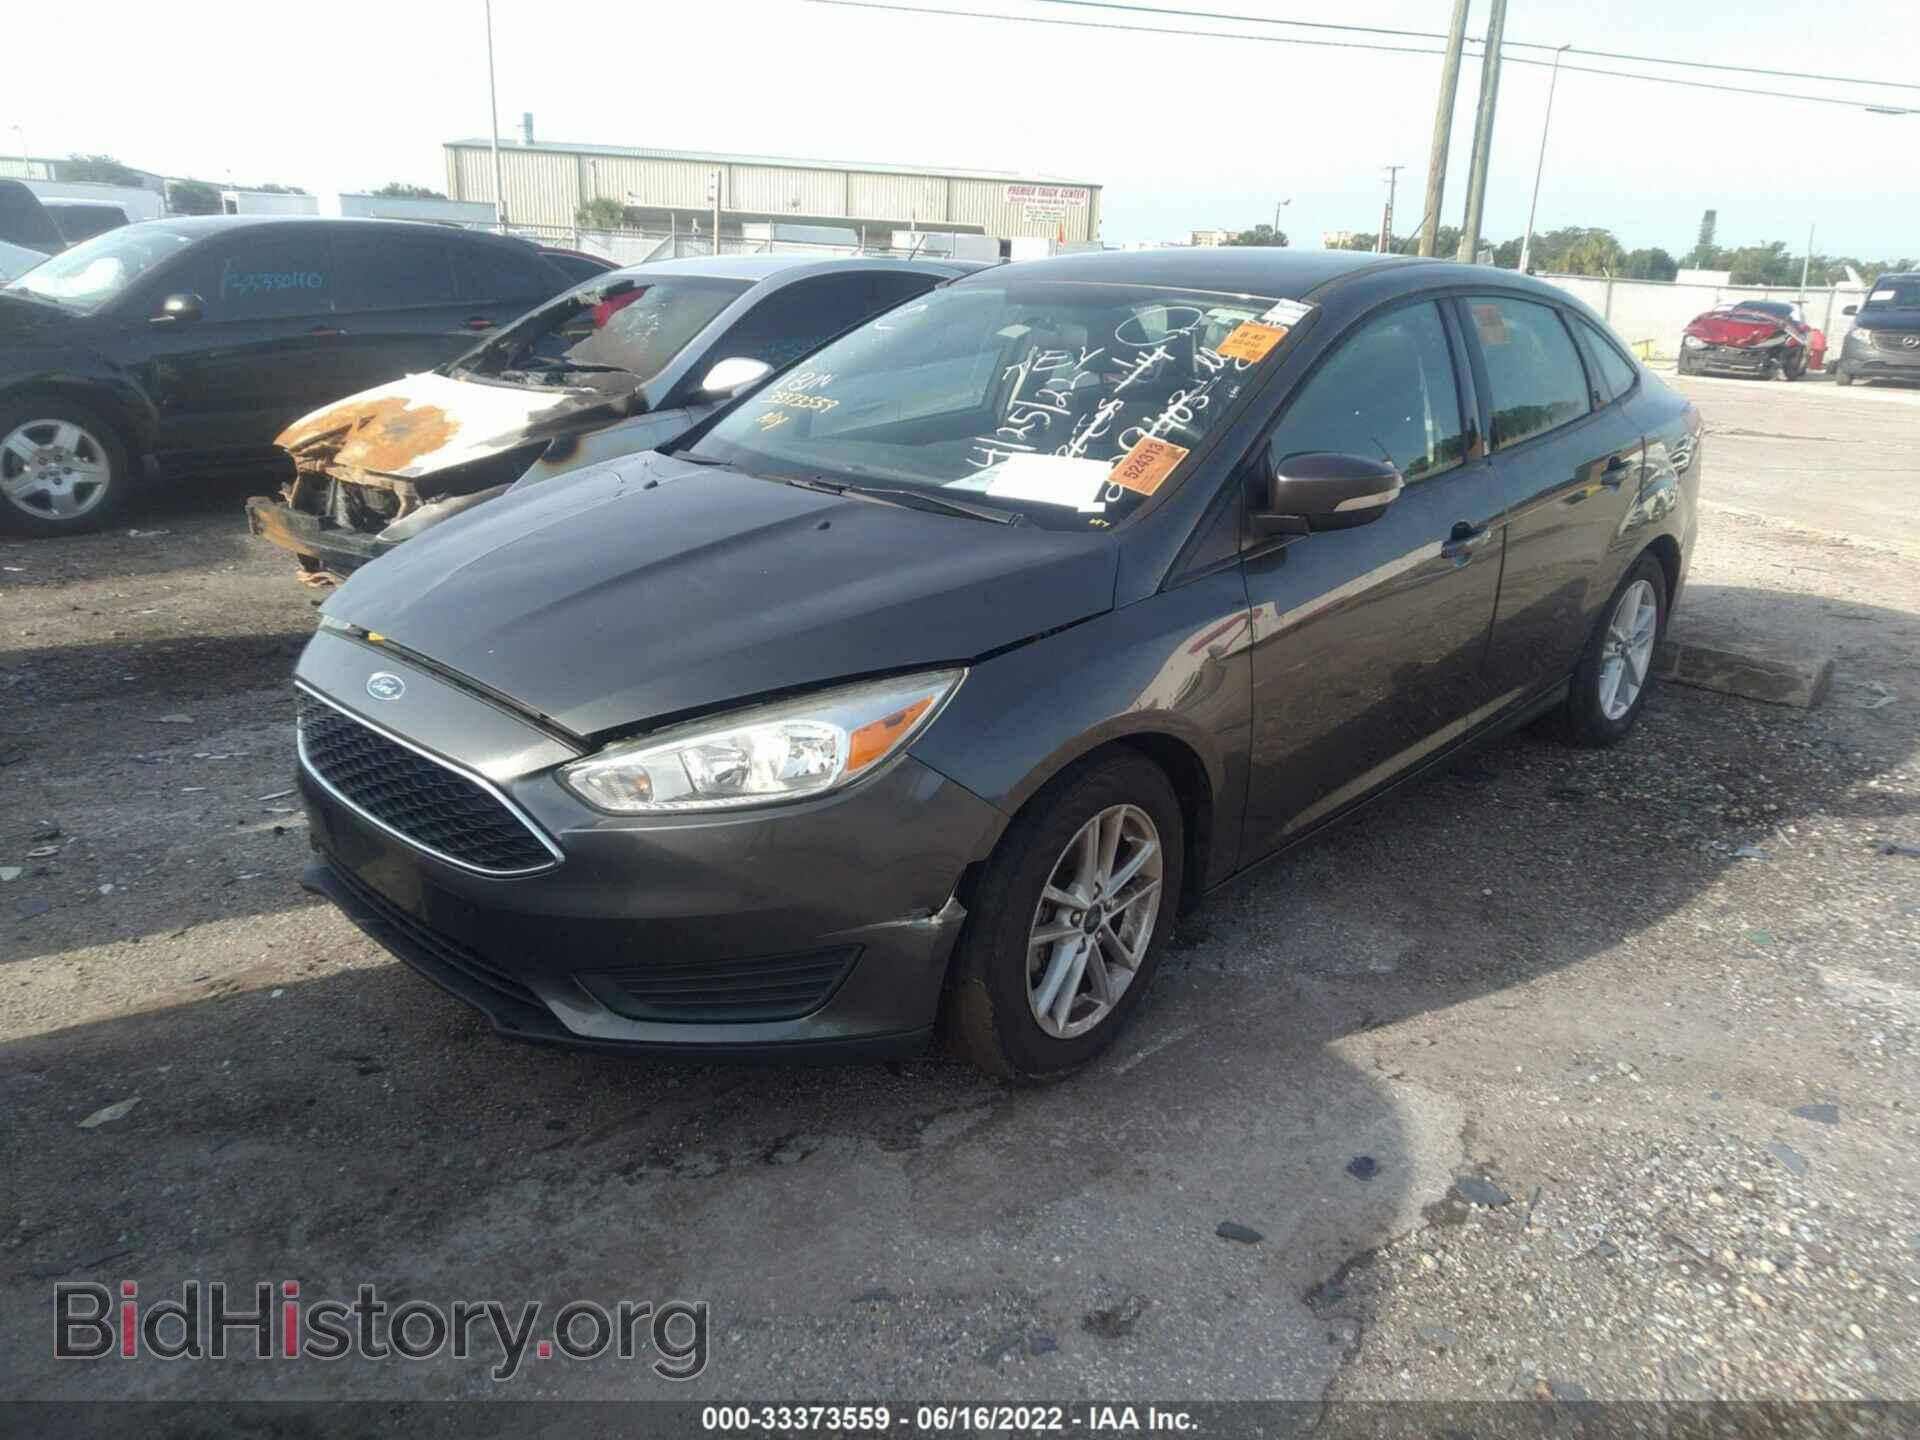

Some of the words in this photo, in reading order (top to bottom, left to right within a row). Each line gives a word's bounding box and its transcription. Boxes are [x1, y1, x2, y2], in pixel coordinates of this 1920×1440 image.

[1008, 186, 1036, 196] PREMIER
[1038, 187, 1058, 197] TRUCK
[1060, 189, 1086, 199] CENTER
[1123, 443, 1164, 480] 524313
